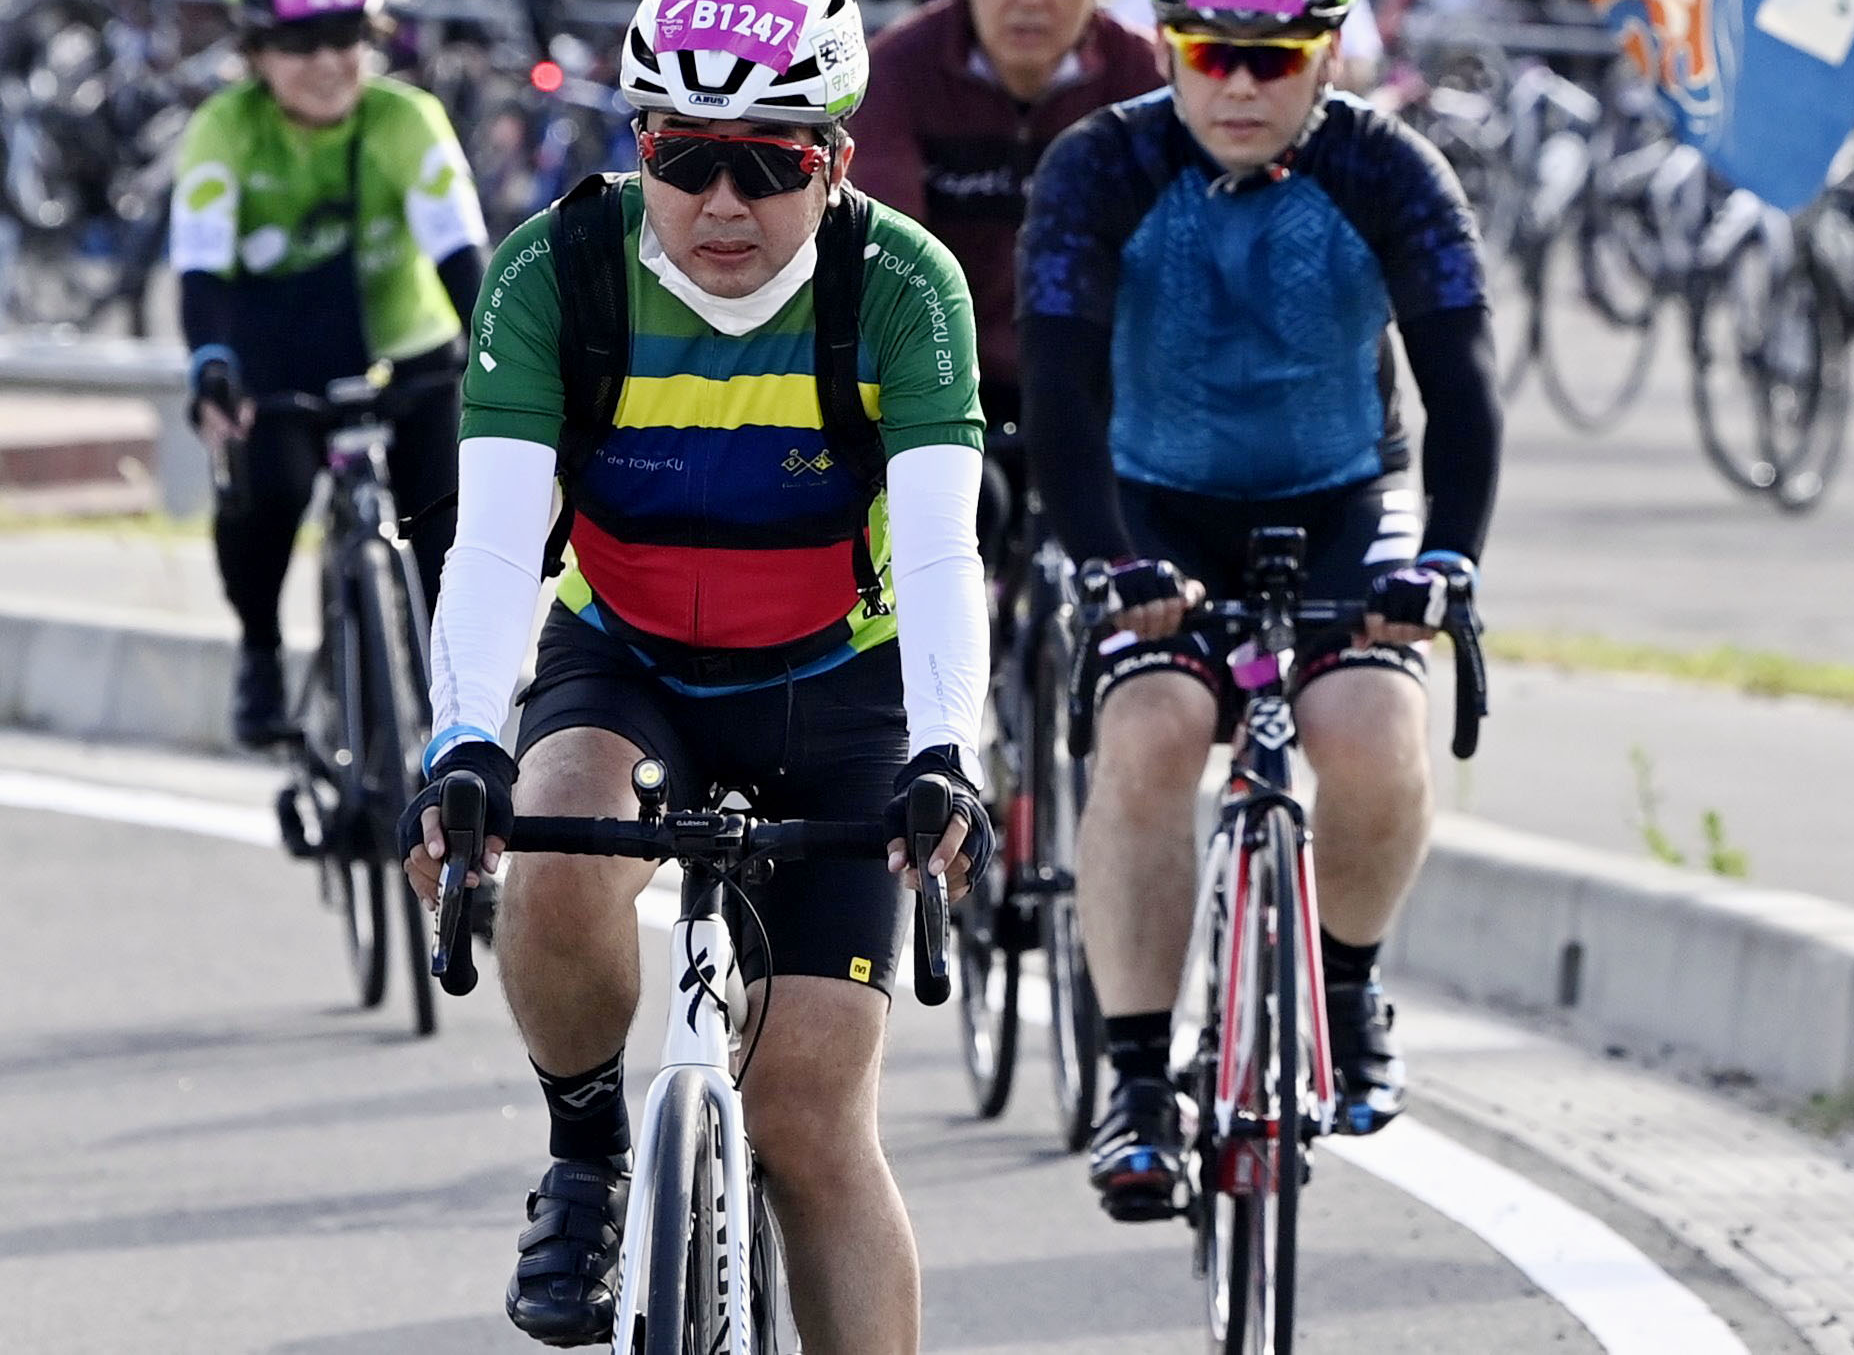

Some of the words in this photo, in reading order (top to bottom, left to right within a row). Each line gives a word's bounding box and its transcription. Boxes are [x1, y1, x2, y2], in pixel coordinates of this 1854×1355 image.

[691, 0, 794, 47] B1247
[694, 95, 724, 105] ABUS
[491, 287, 504, 308] de
[500, 238, 550, 287] TOHOKU
[908, 274, 927, 289] de
[921, 286, 949, 344] TOHOKU
[935, 349, 954, 386] 2019
[628, 457, 684, 472] TOHOKU
[676, 819, 709, 827] GARMIN
